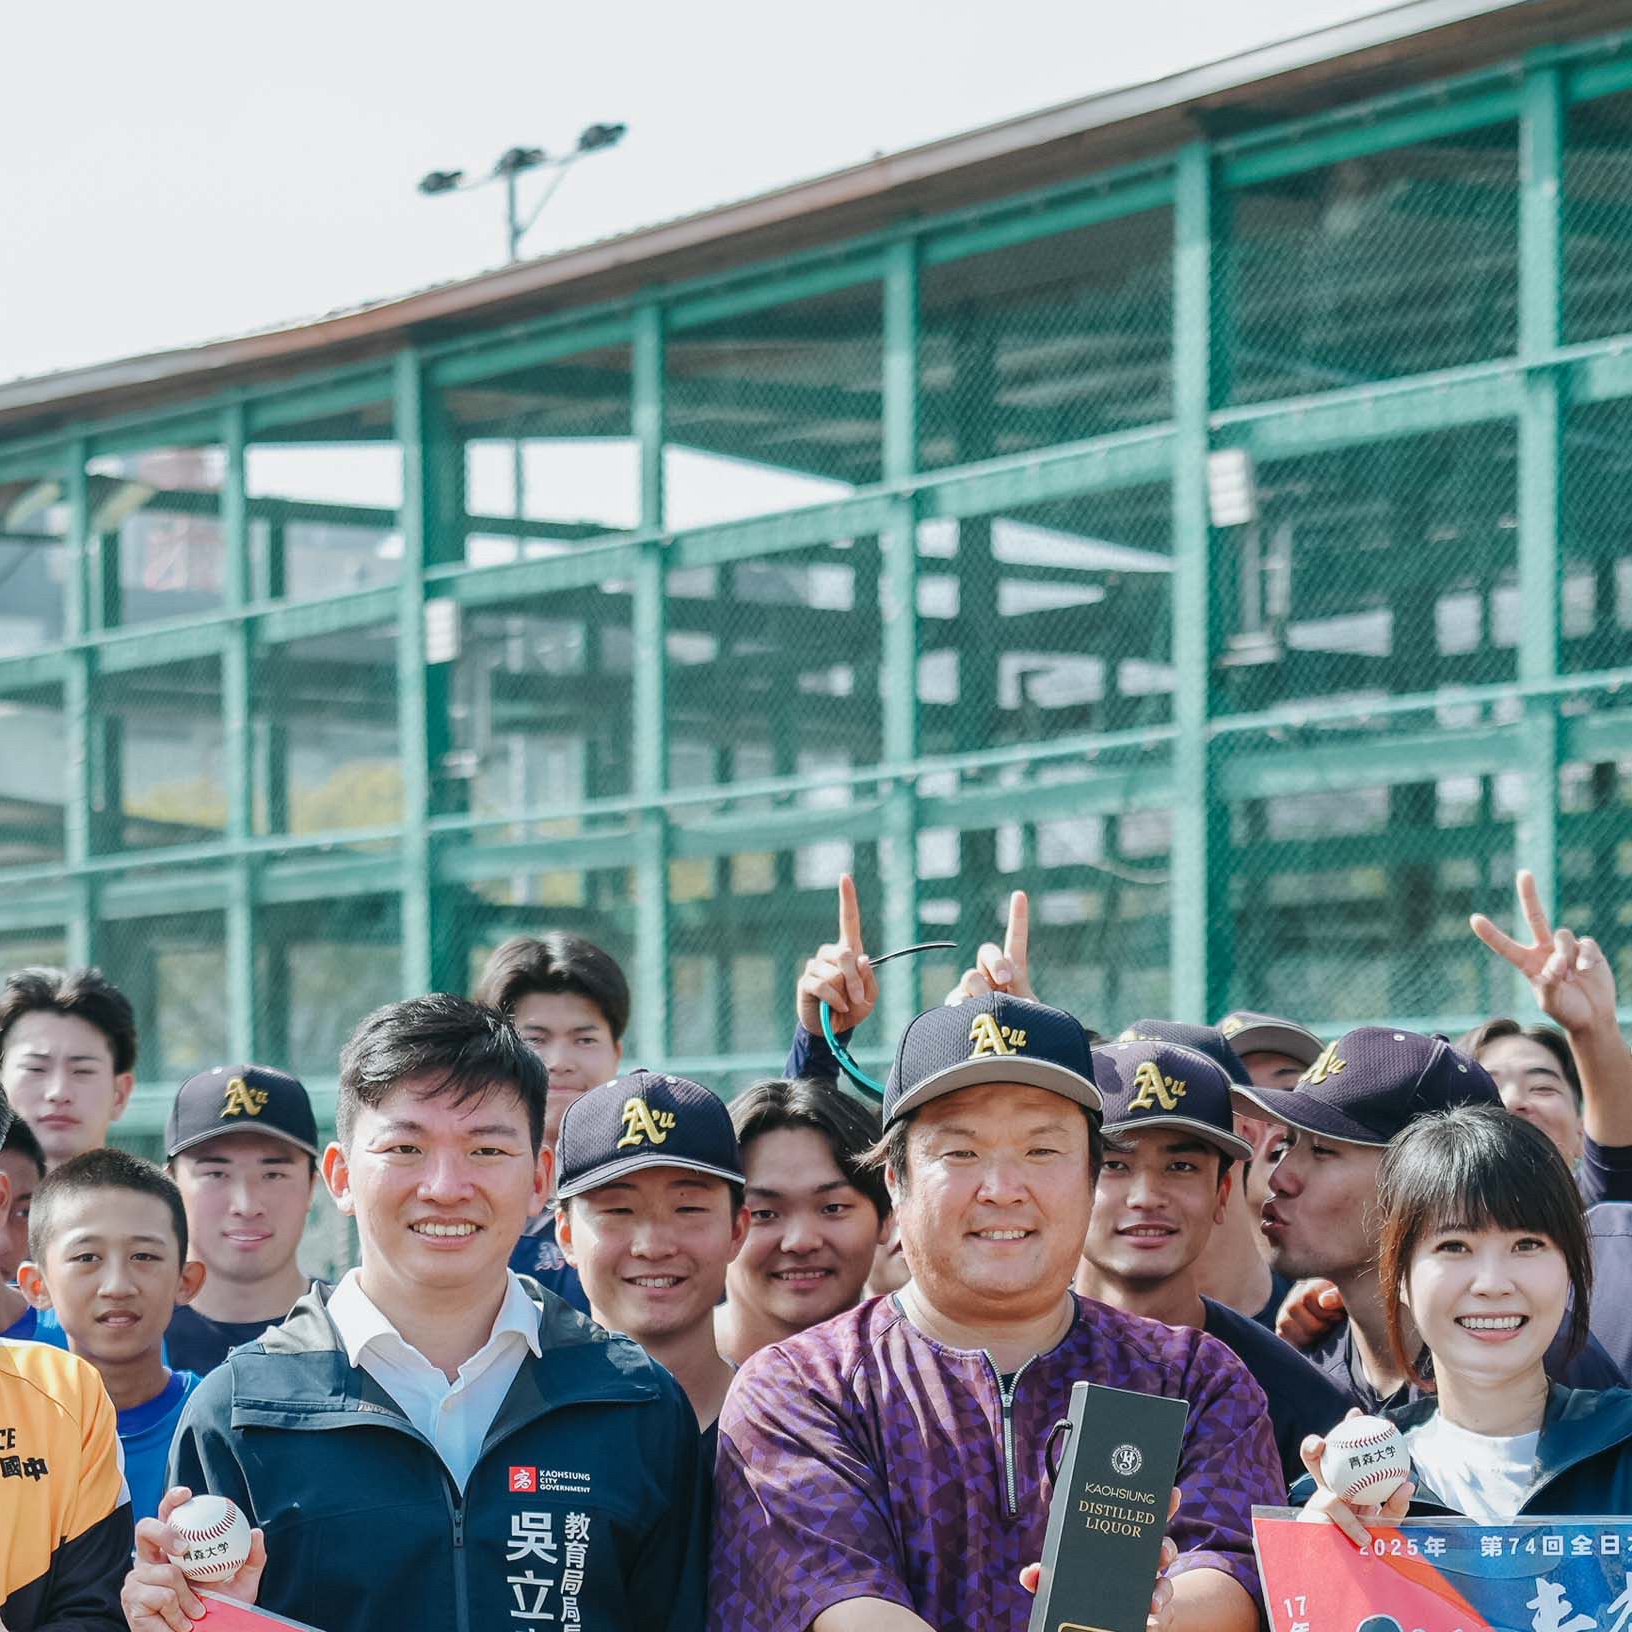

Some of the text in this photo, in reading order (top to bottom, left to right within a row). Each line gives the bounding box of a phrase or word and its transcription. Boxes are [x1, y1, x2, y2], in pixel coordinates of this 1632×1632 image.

[539, 1469, 591, 1481] KAOHSIUNG
[539, 1484, 591, 1493] GOVERNMENT
[1085, 1482, 1155, 1504] KAOHSIUNG
[1078, 1500, 1155, 1525] DISTILLED
[1086, 1516, 1142, 1538] LIQUOR
